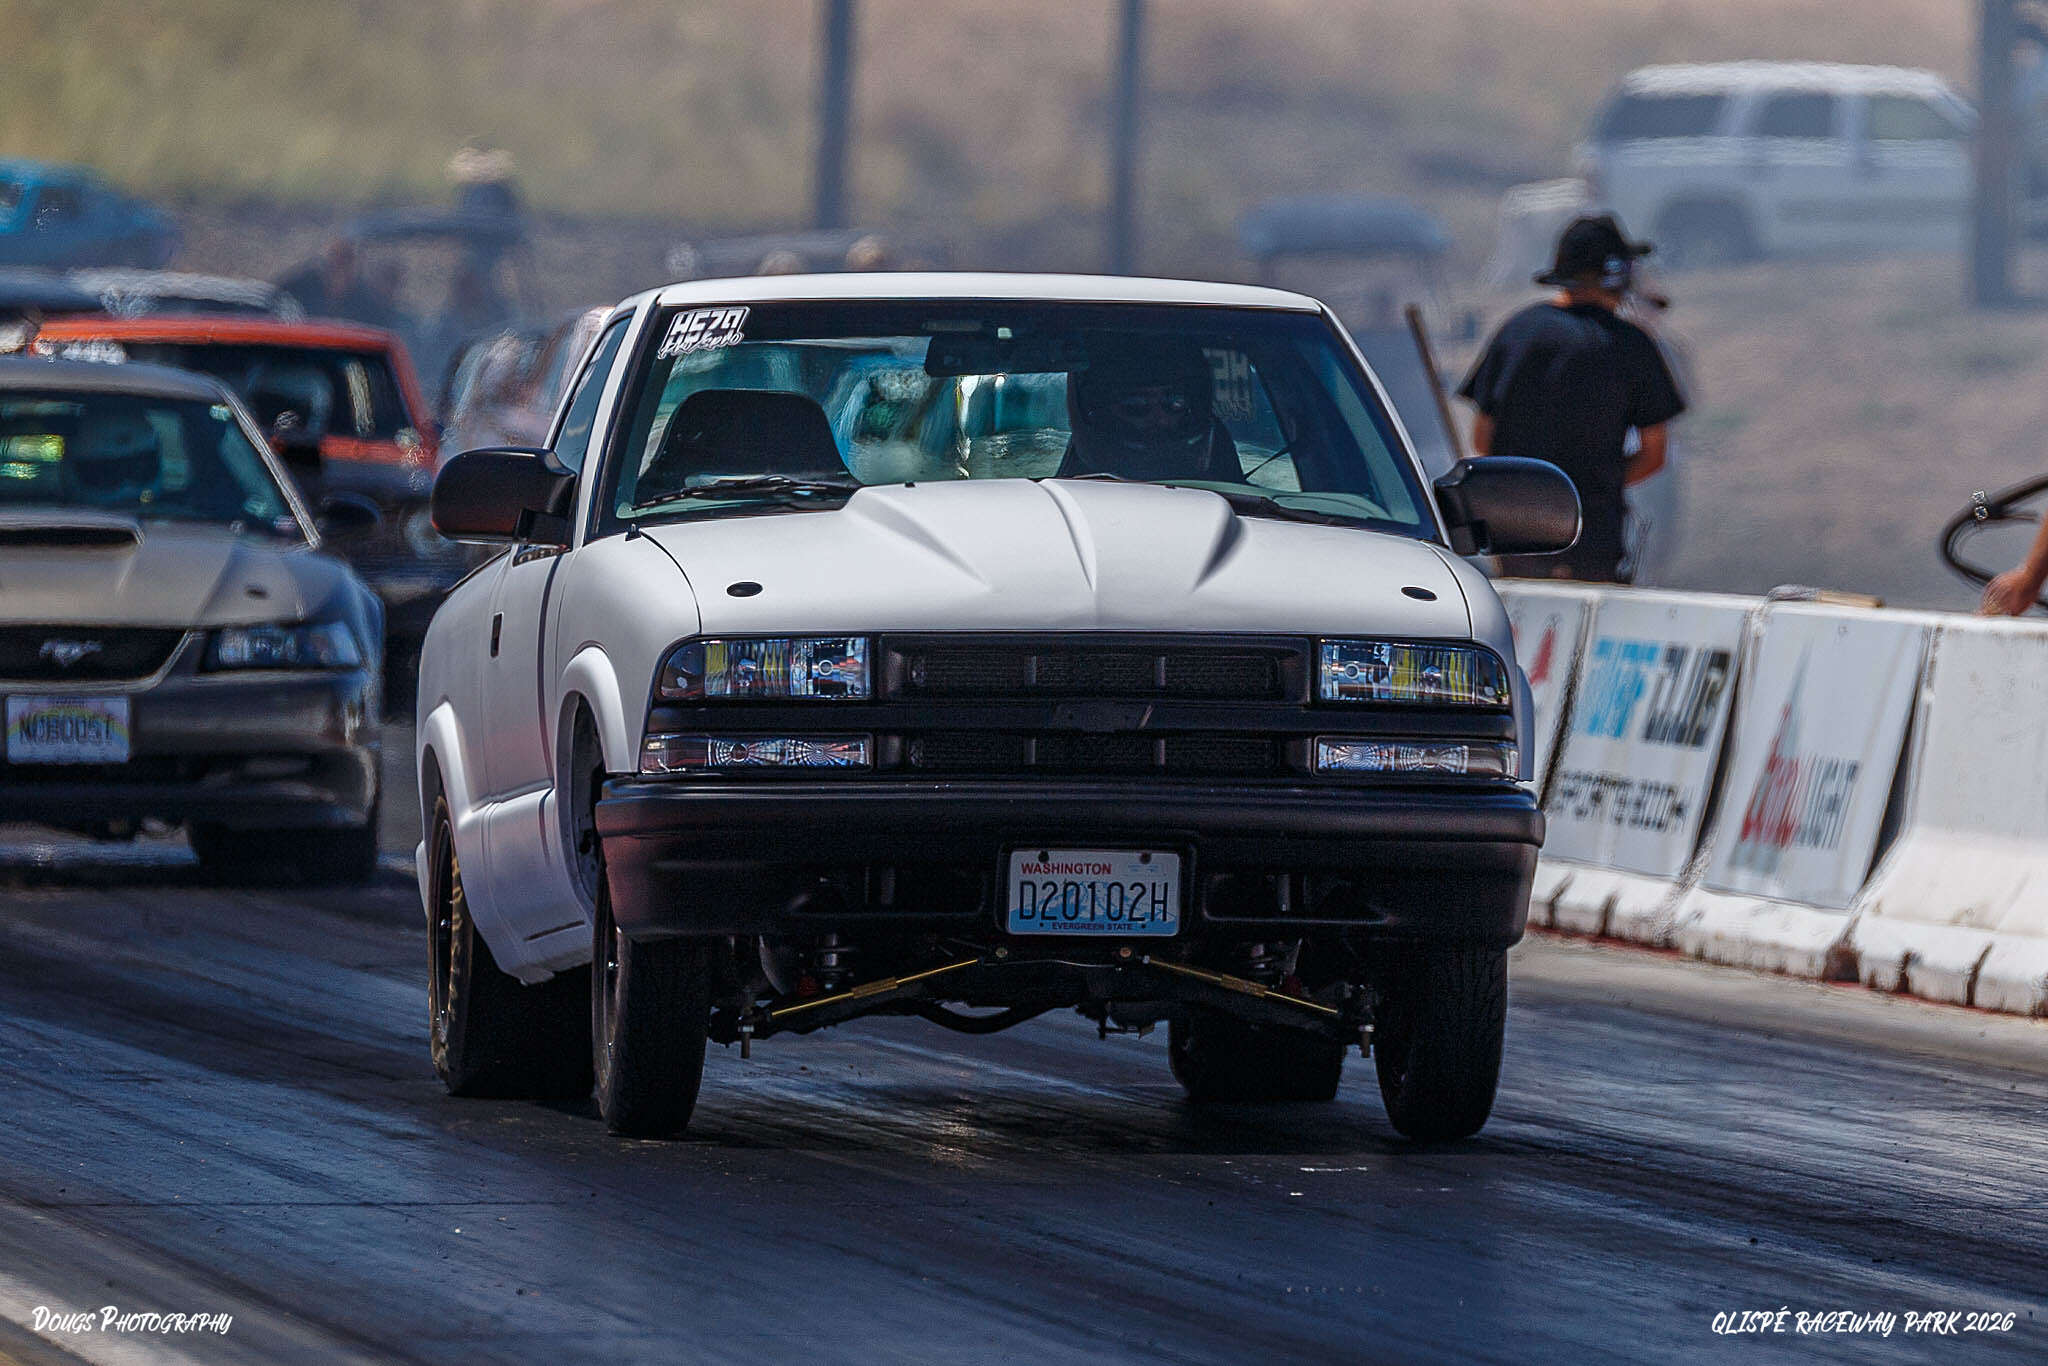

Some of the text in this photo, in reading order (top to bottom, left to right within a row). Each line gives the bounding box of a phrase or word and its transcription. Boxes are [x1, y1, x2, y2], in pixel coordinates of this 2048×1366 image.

[1021, 863, 1112, 875] WASHINGTON
[1019, 880, 1168, 922] D20102H
[1052, 922, 1132, 931] EVERGREEN STATE
